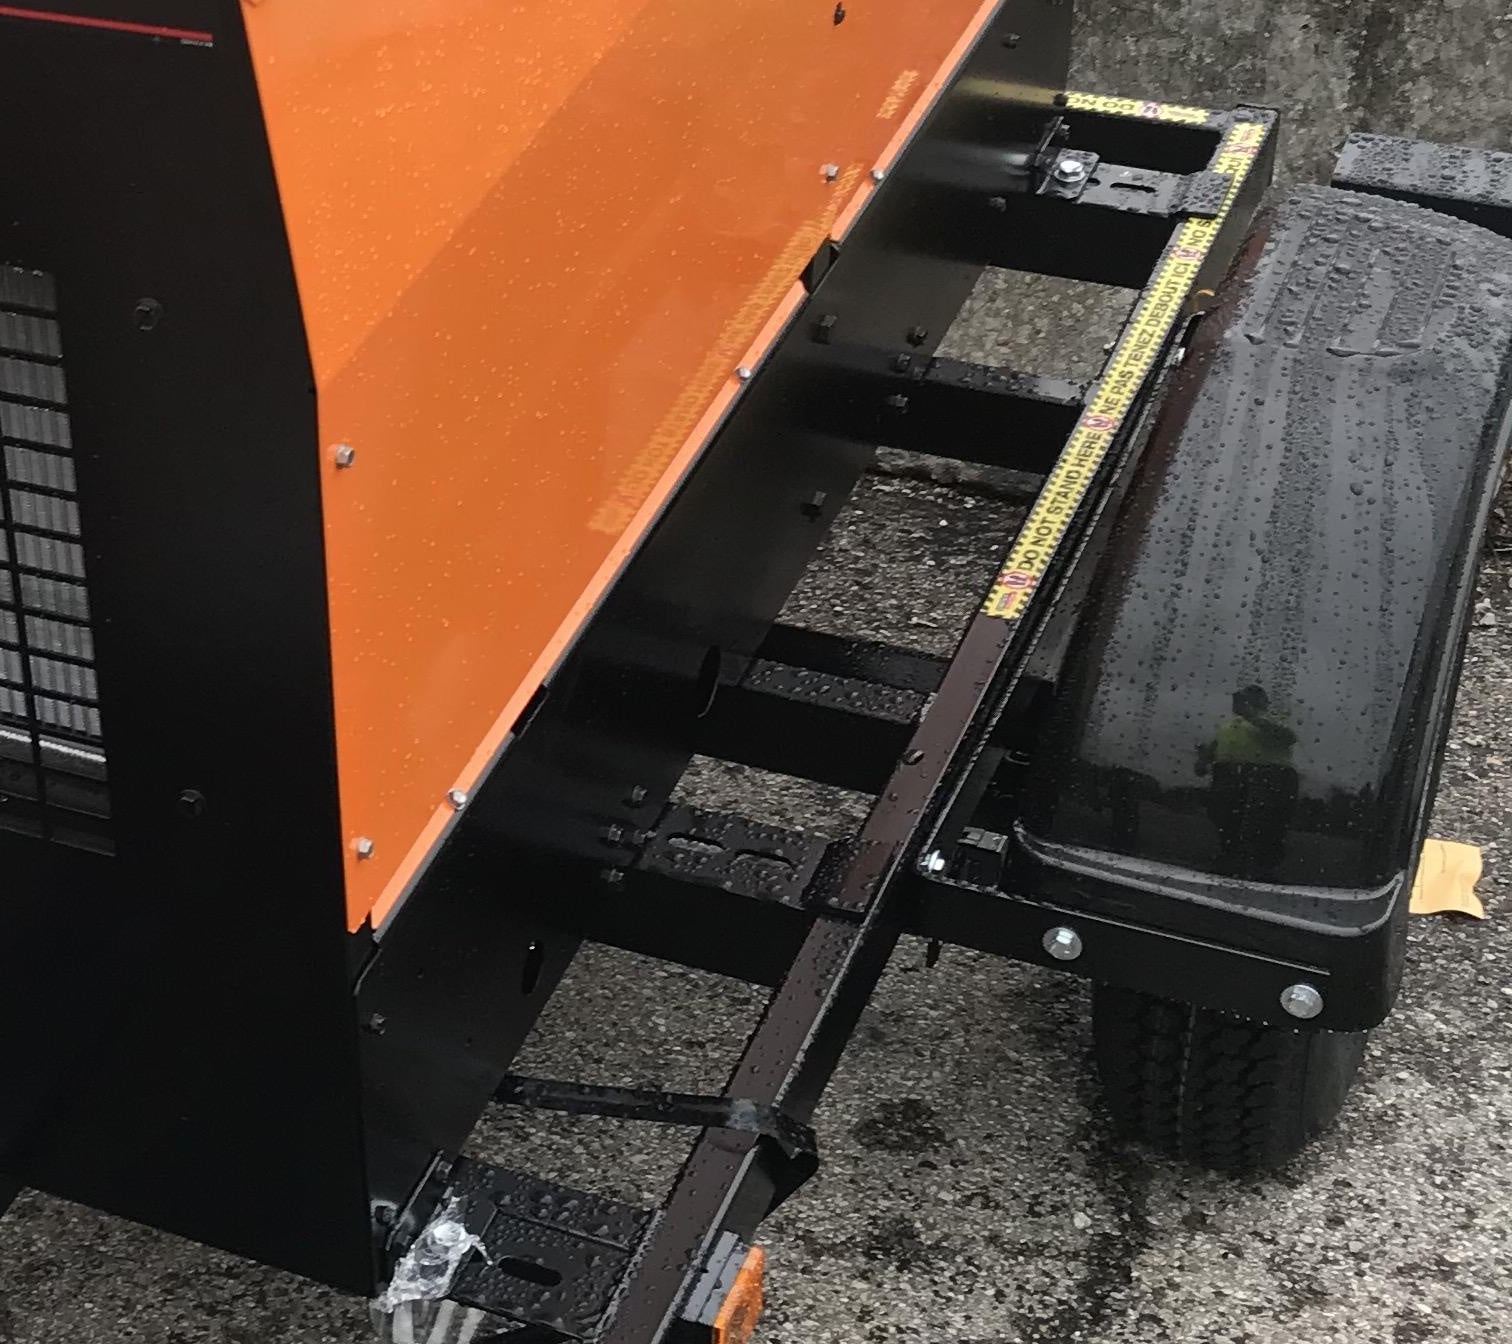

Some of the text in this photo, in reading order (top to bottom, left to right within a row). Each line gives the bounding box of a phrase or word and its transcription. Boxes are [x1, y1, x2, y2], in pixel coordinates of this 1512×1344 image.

[1190, 229, 1206, 247] NO
[1101, 262, 1189, 414] NE PAS TENEZ DEBOUT ICI
[1018, 431, 1103, 570] DO NOT STAND HERE
